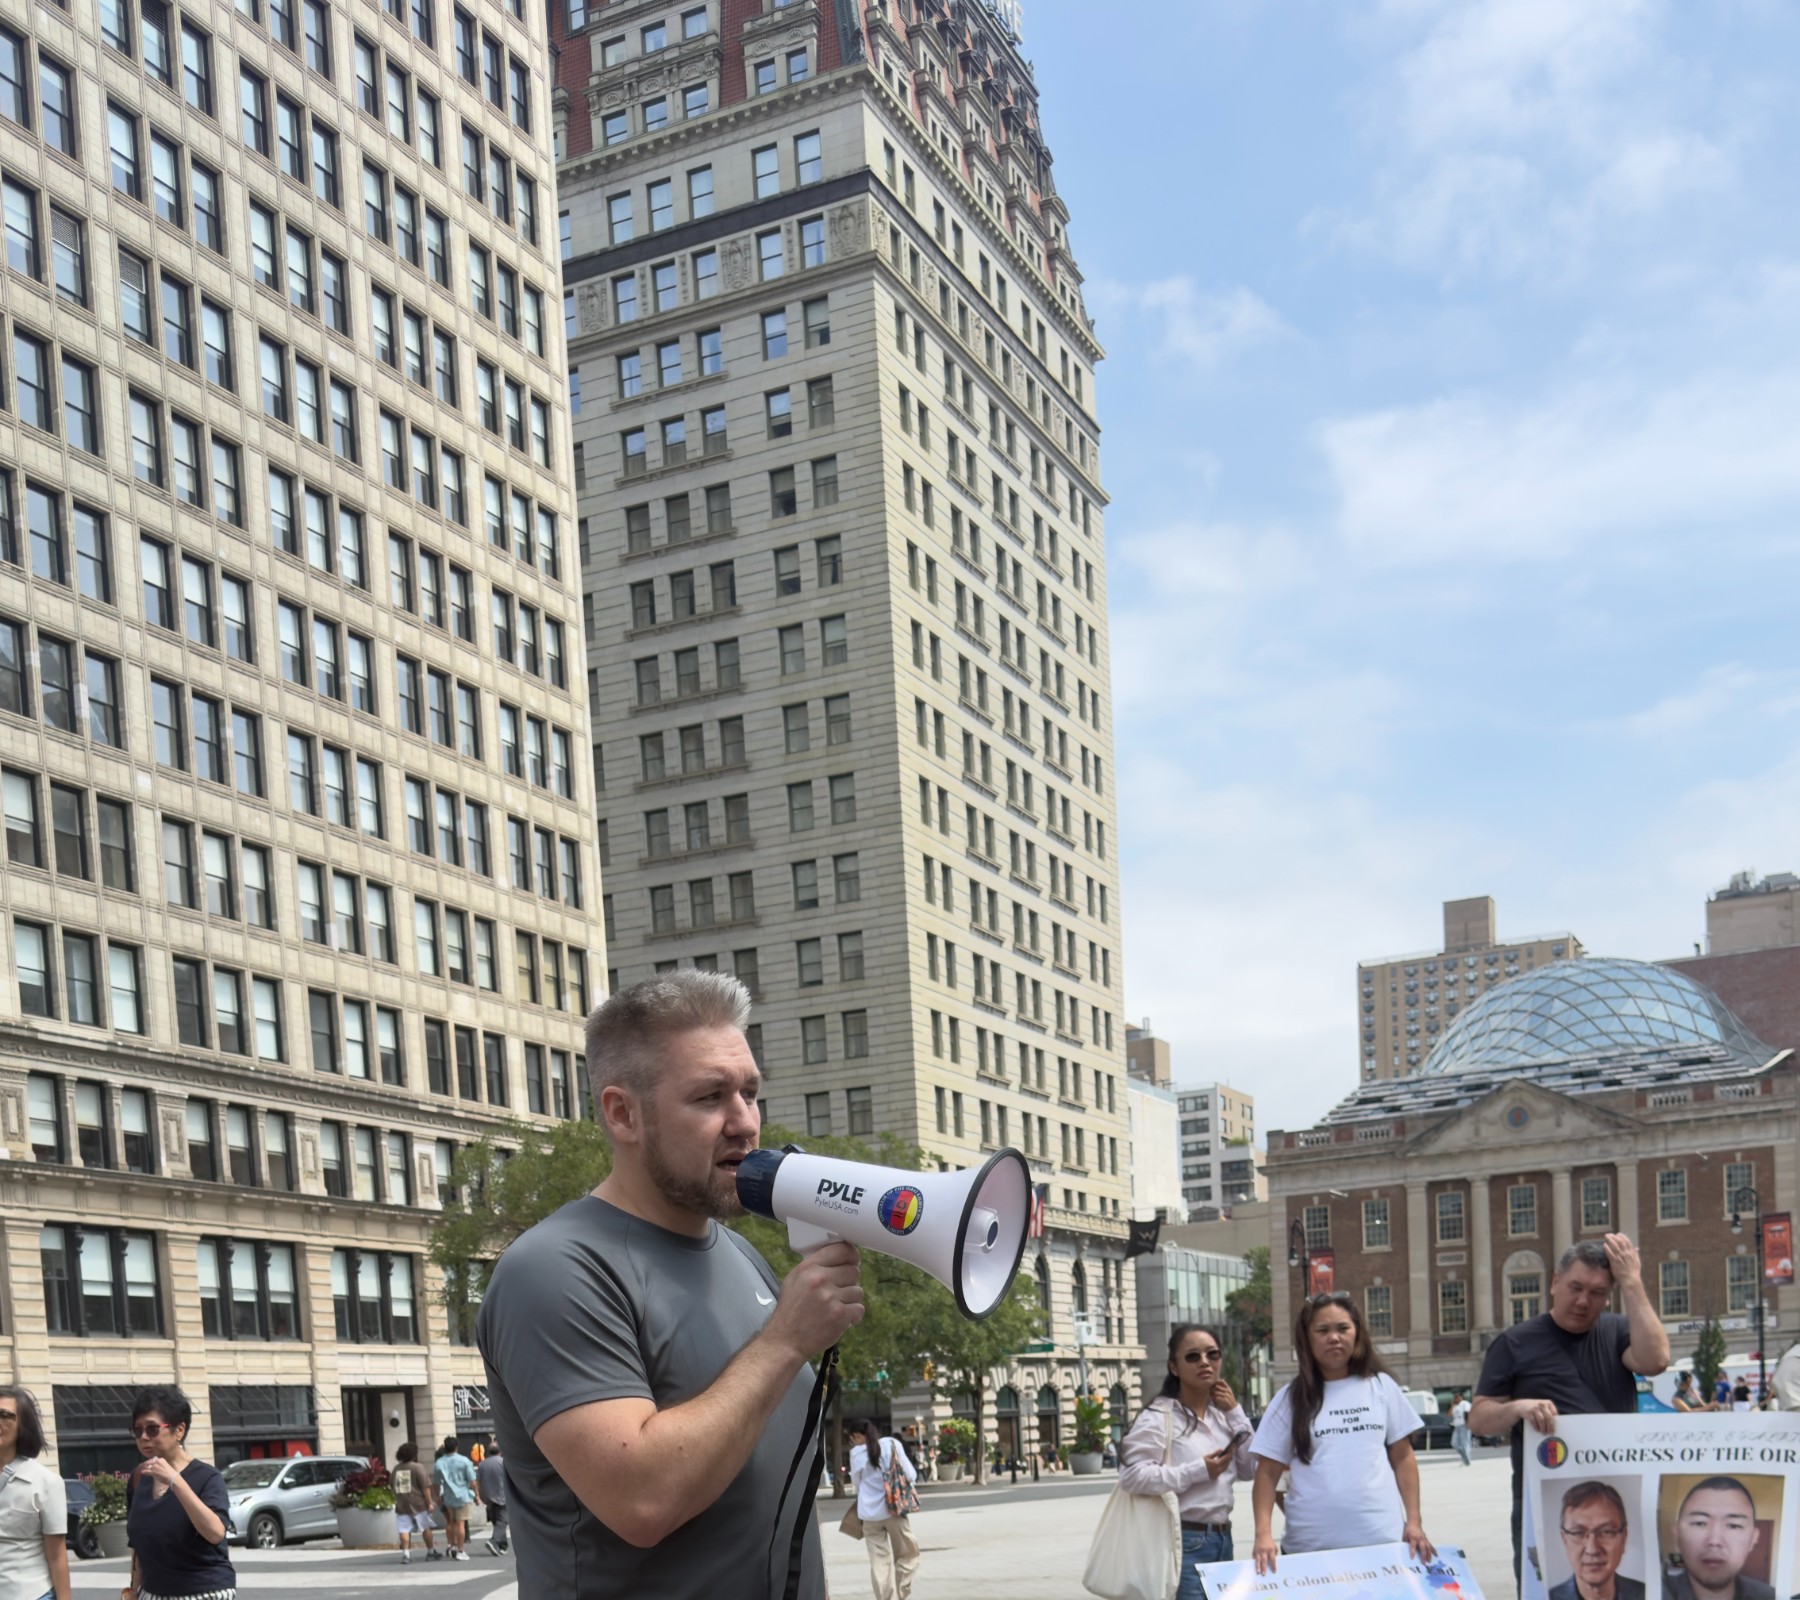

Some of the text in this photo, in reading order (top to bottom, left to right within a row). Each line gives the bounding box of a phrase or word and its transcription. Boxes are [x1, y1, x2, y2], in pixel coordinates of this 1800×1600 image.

[815, 1197, 859, 1215] PyleUSA.com
[1329, 1406, 1370, 1416] FREEDOM
[1342, 1416, 1360, 1424] FOR
[1314, 1427, 1350, 1438] CAPTIVE
[1574, 1447, 1800, 1465] CONGRESS OF THE OIR
[1282, 1570, 1378, 1589] Colonialism
